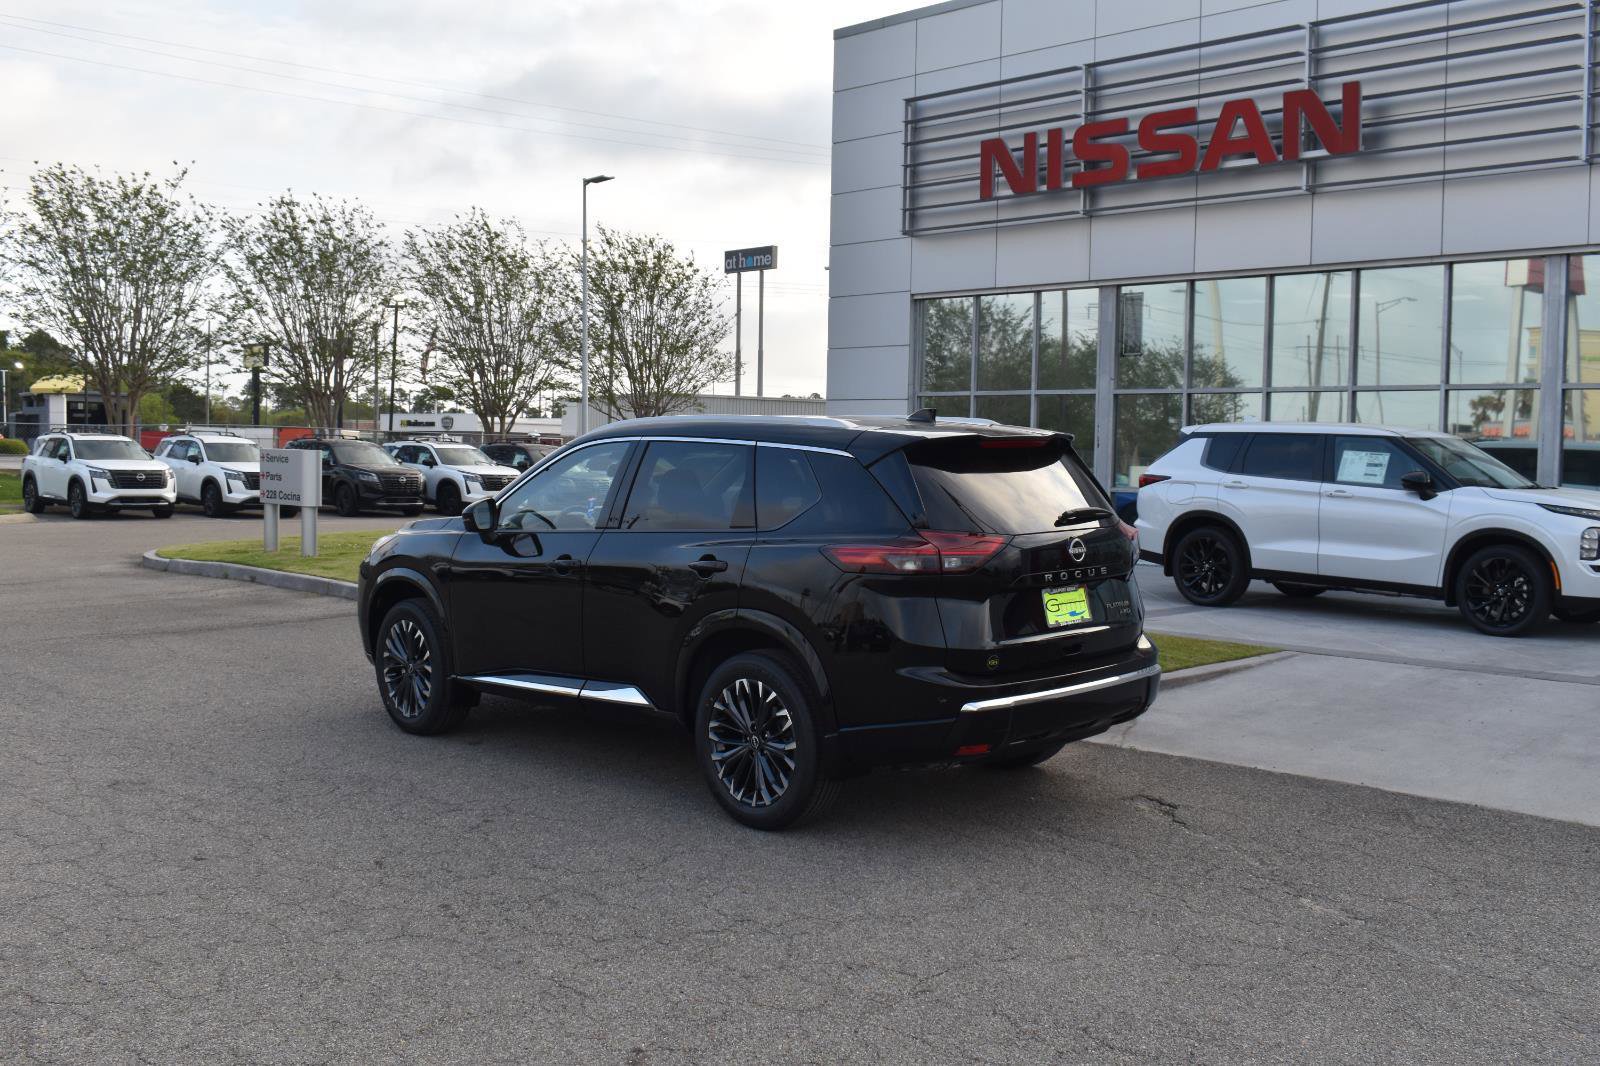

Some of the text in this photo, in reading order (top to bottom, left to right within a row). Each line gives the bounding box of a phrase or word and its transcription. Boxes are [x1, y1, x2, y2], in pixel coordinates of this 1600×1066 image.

[979, 80, 1361, 201] NISSAN
[725, 252, 772, 270] at home
[265, 453, 289, 464] Service
[265, 471, 282, 482] Parts
[266, 489, 301, 502] 228 Cocina
[1044, 566, 1108, 582] ROGUE
